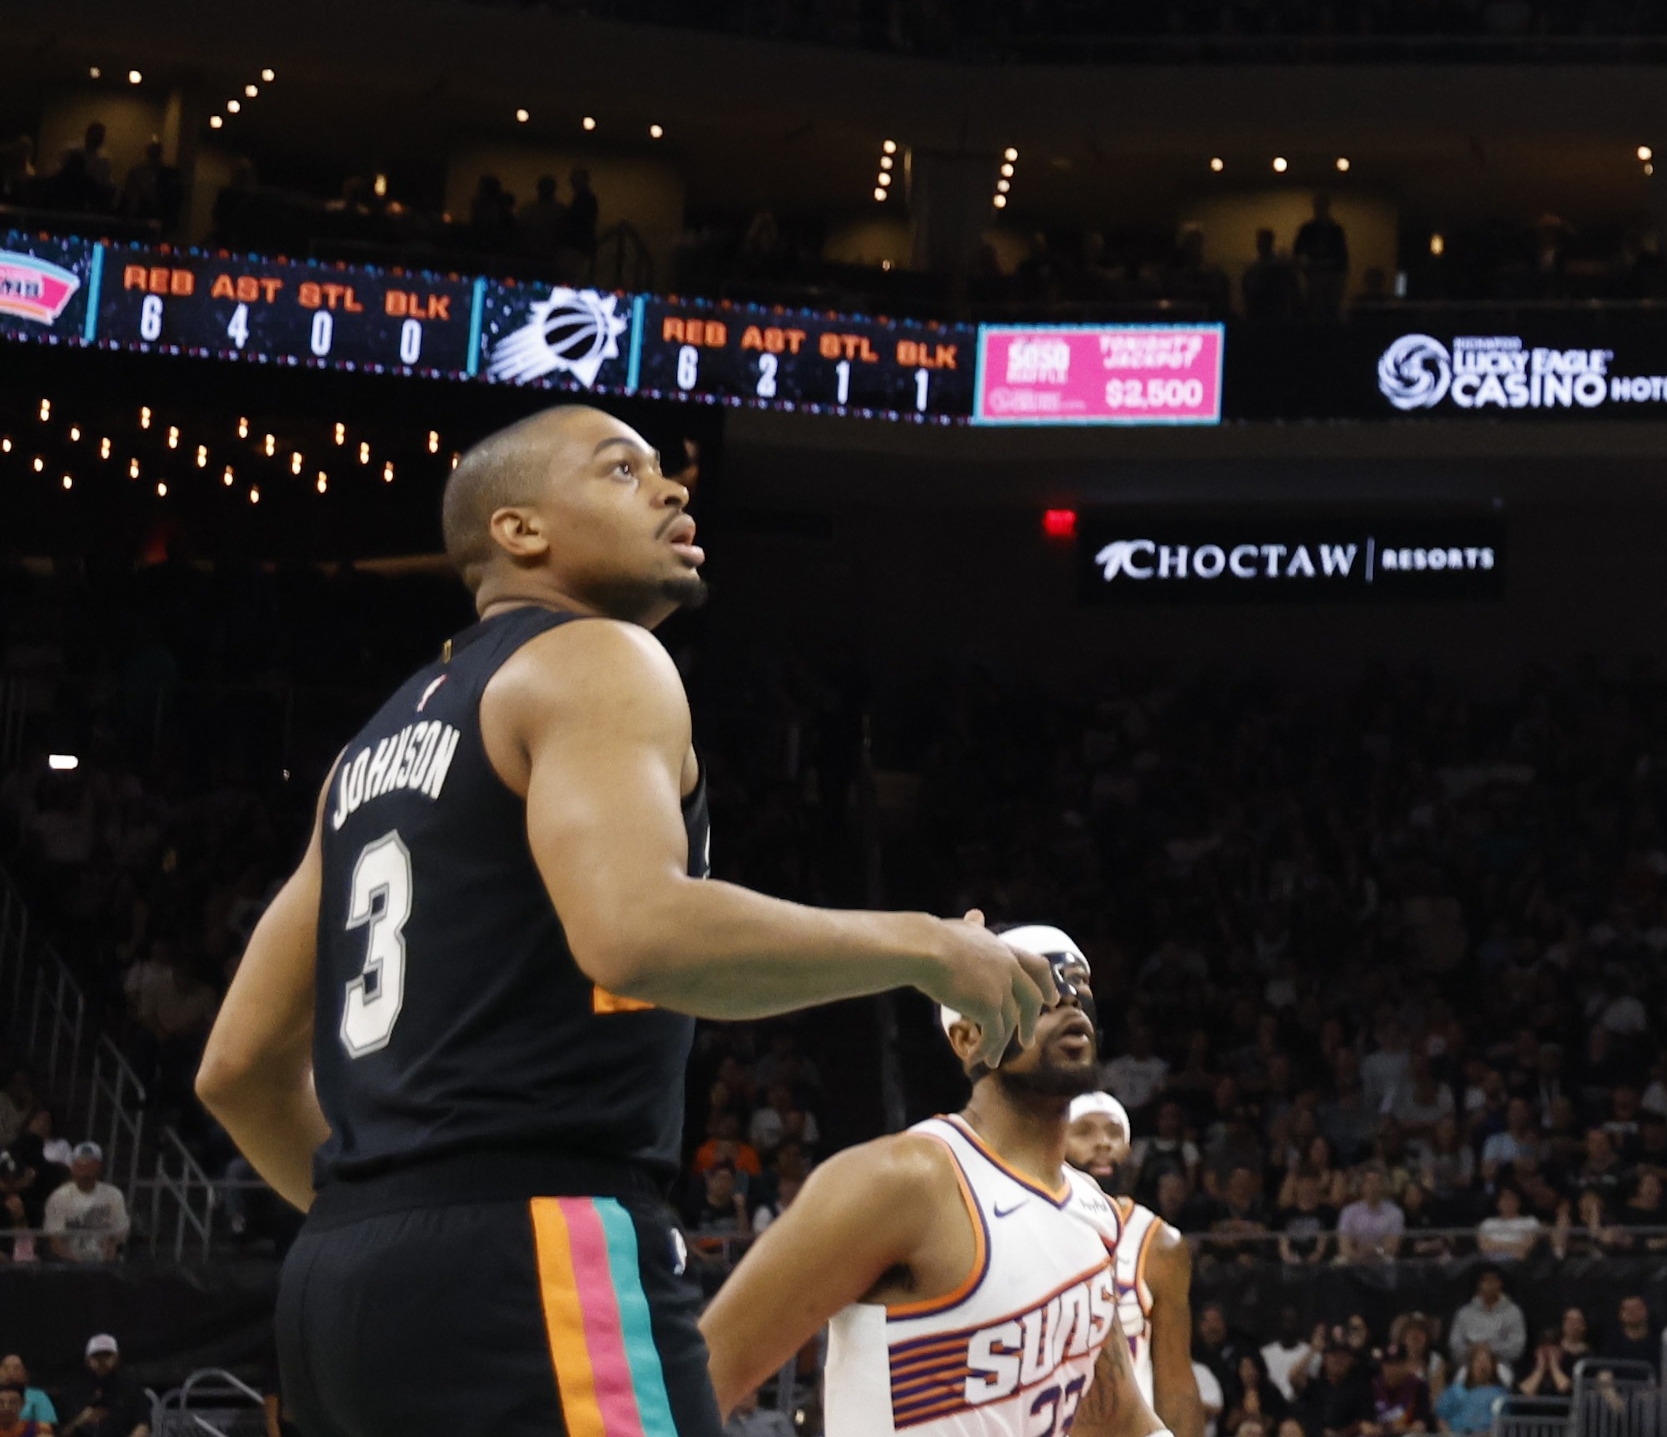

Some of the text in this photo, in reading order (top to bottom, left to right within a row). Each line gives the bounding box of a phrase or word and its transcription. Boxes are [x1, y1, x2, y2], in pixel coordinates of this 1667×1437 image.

[139, 294, 423, 365] 6 4 0 0
[677, 344, 929, 412] 6 2 1 1
[1105, 378, 1204, 409] $2,500
[1451, 372, 1608, 408] CASINO
[1118, 539, 1496, 580] CHOCTAW RESORTS
[333, 719, 461, 831] JOHNSON
[339, 828, 413, 1060] 3
[964, 1268, 1115, 1405] SUNS
